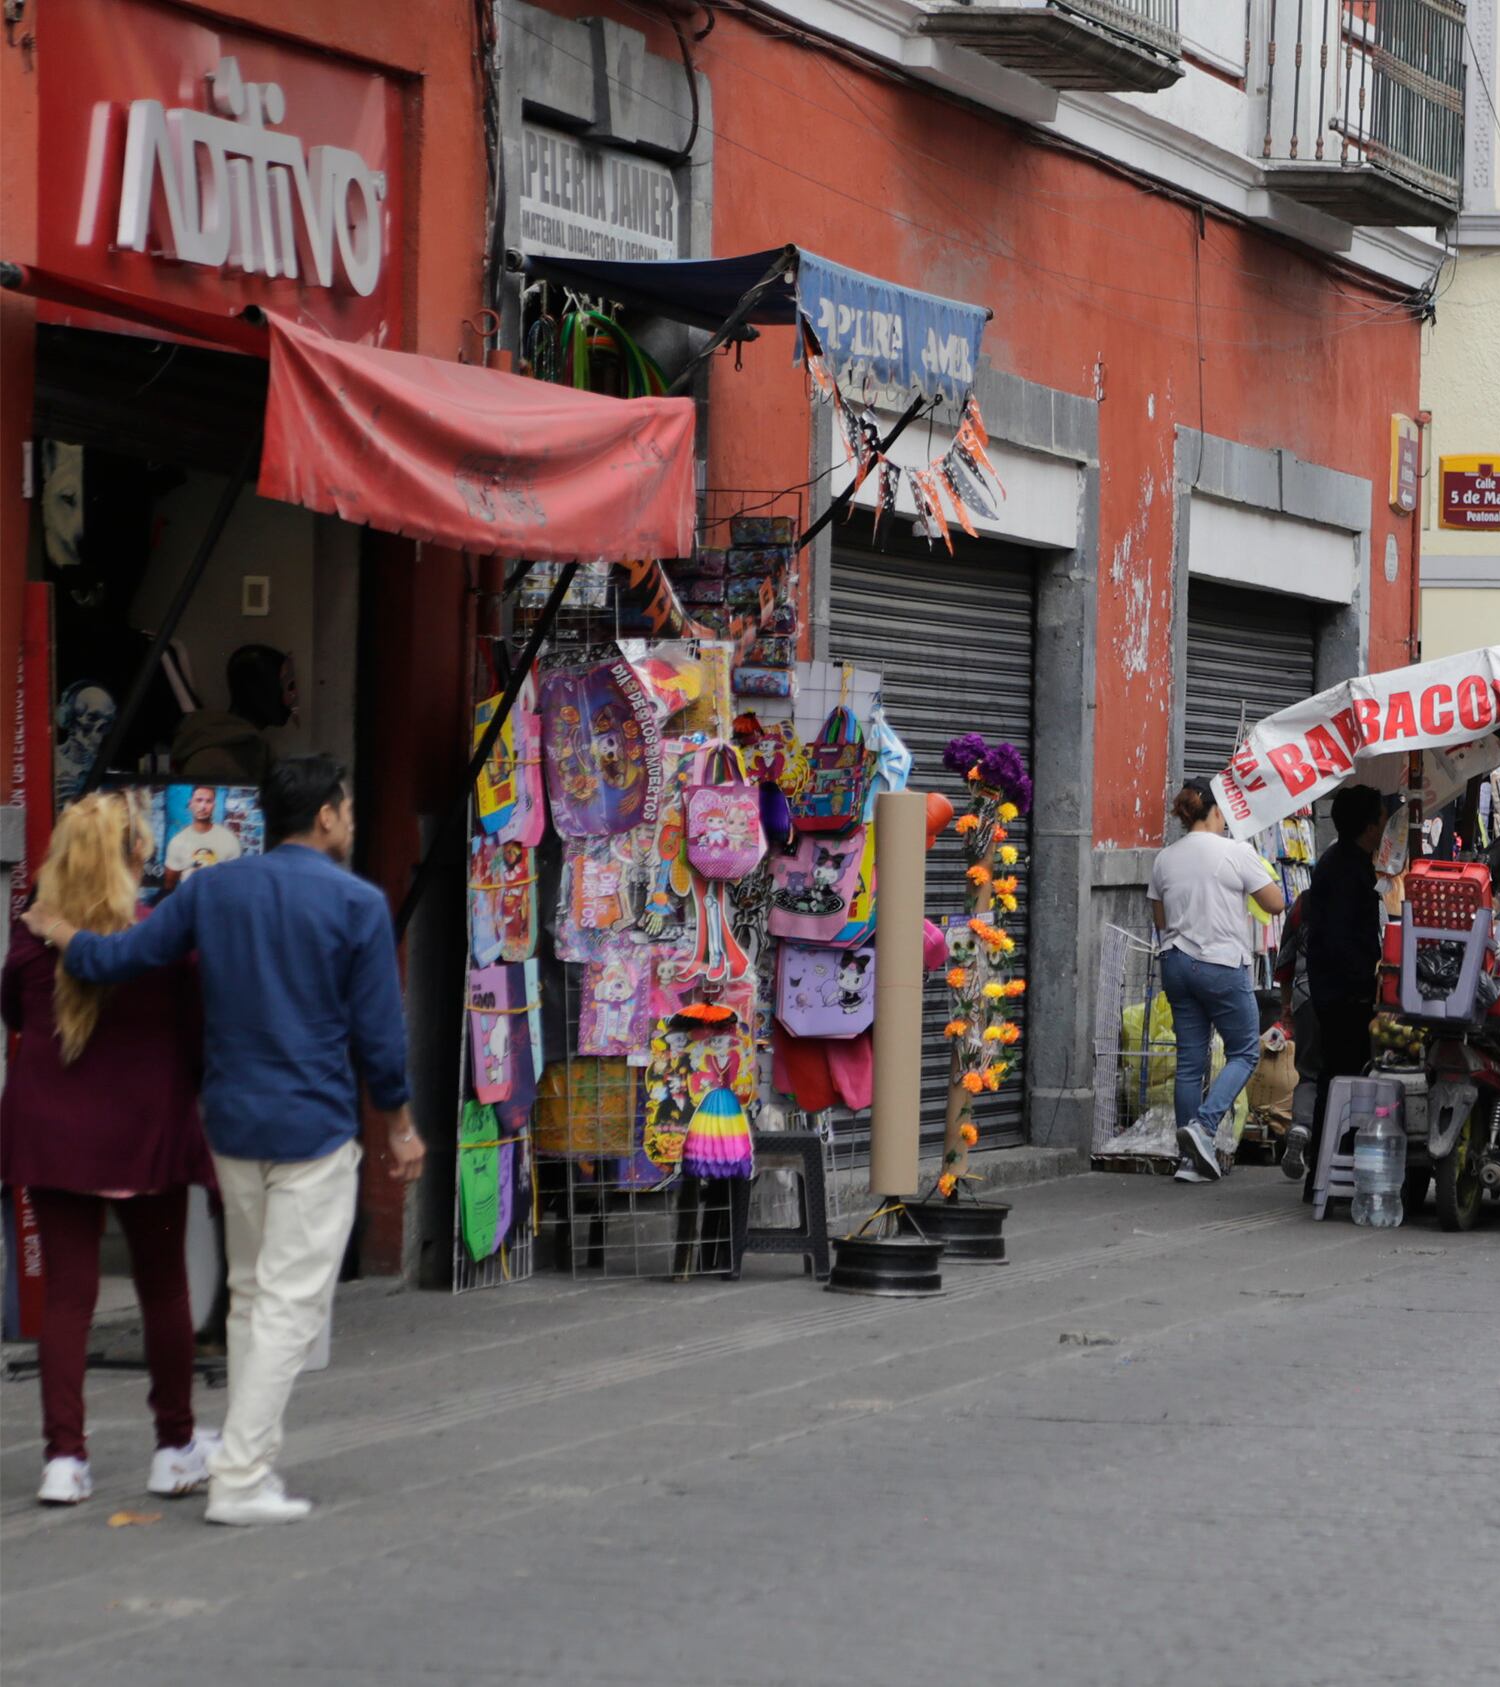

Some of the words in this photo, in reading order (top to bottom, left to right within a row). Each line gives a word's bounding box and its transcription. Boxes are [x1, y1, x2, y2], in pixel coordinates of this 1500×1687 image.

[521, 130, 607, 222] PELERIA
[611, 158, 675, 242] JAMER
[522, 210, 566, 249] MATERIAL
[617, 238, 625, 260] Y
[1451, 491, 1459, 504] 5
[1463, 491, 1479, 504] de
[1475, 478, 1496, 490] Calle
[643, 756, 663, 823] MUERTOS
[1219, 769, 1252, 821] PUERCO
